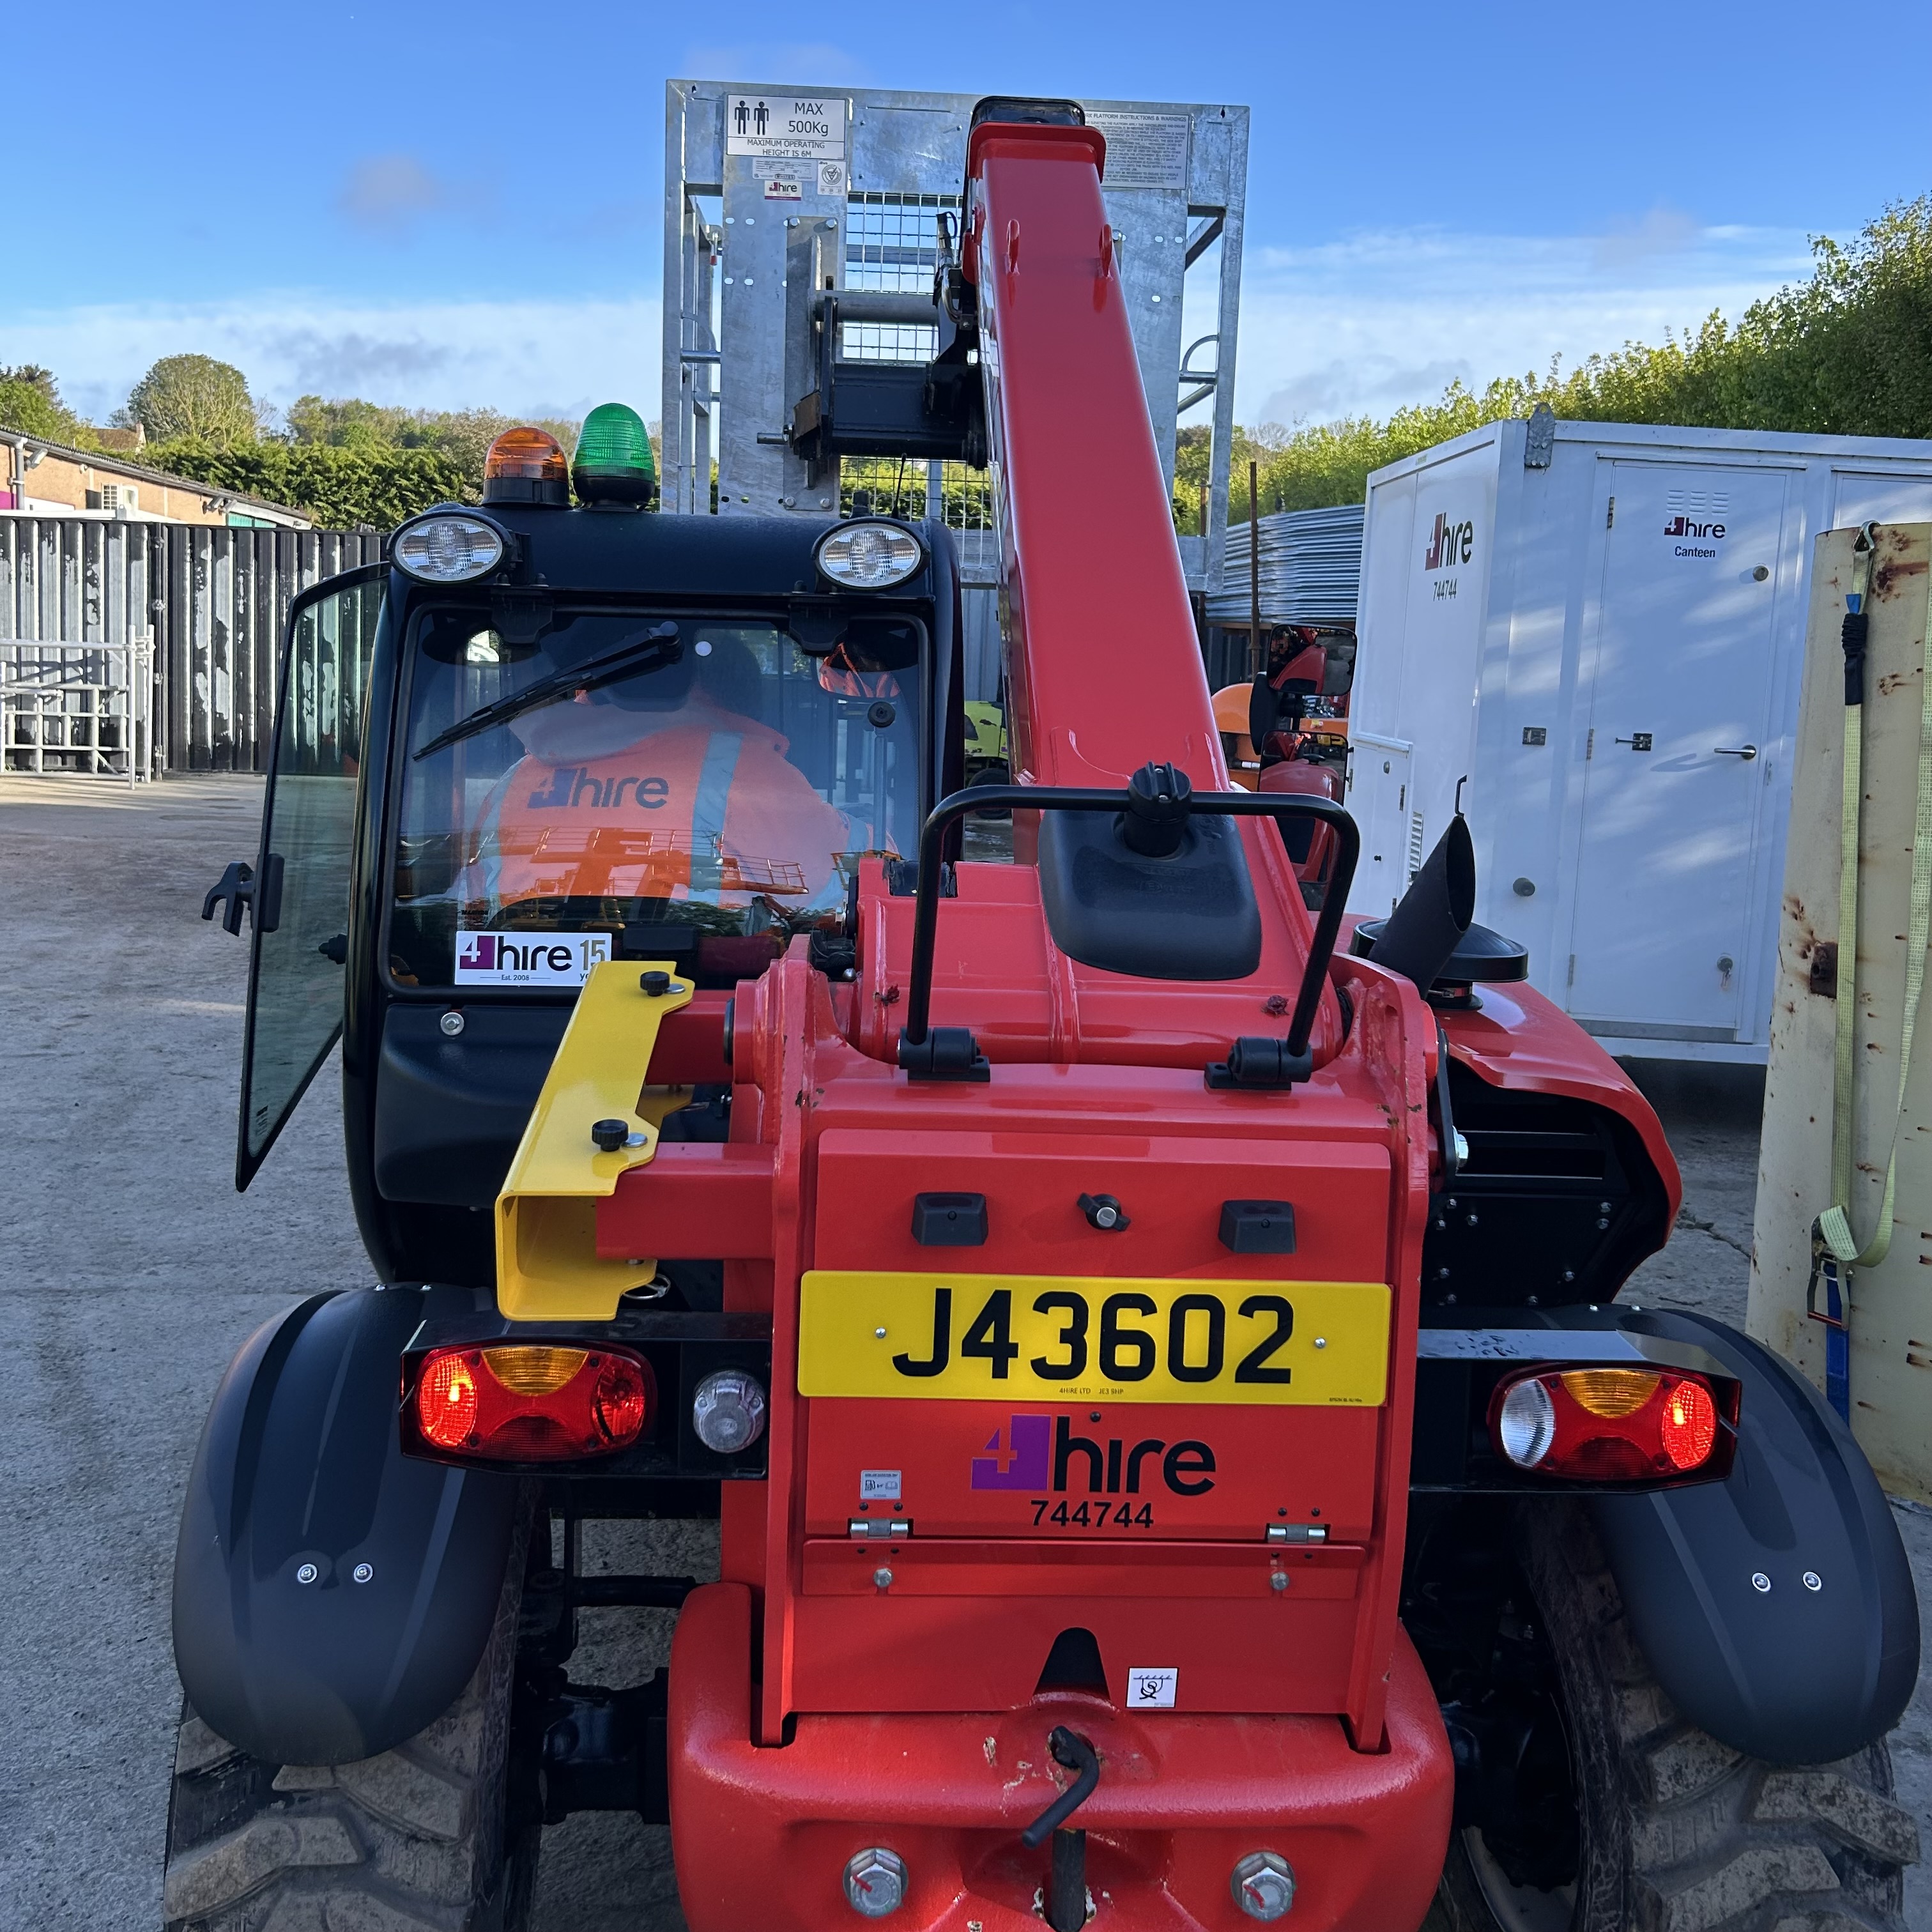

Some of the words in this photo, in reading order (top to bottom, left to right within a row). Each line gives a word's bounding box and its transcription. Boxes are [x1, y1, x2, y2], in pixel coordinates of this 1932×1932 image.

[795, 102, 824, 115] MAX
[788, 120, 829, 137] 500Kg
[747, 139, 782, 147] MAXIMUM
[784, 140, 825, 149] OPERATING
[762, 148, 790, 157] HEIGHT
[1675, 546, 1715, 558] Canteen
[1433, 578, 1457, 601] 744744
[459, 935, 572, 971] 4hire
[579, 939, 606, 970] 15
[892, 1287, 1294, 1384] J43602
[970, 1414, 1216, 1496] 4hire
[1031, 1499, 1154, 1528] 744744
